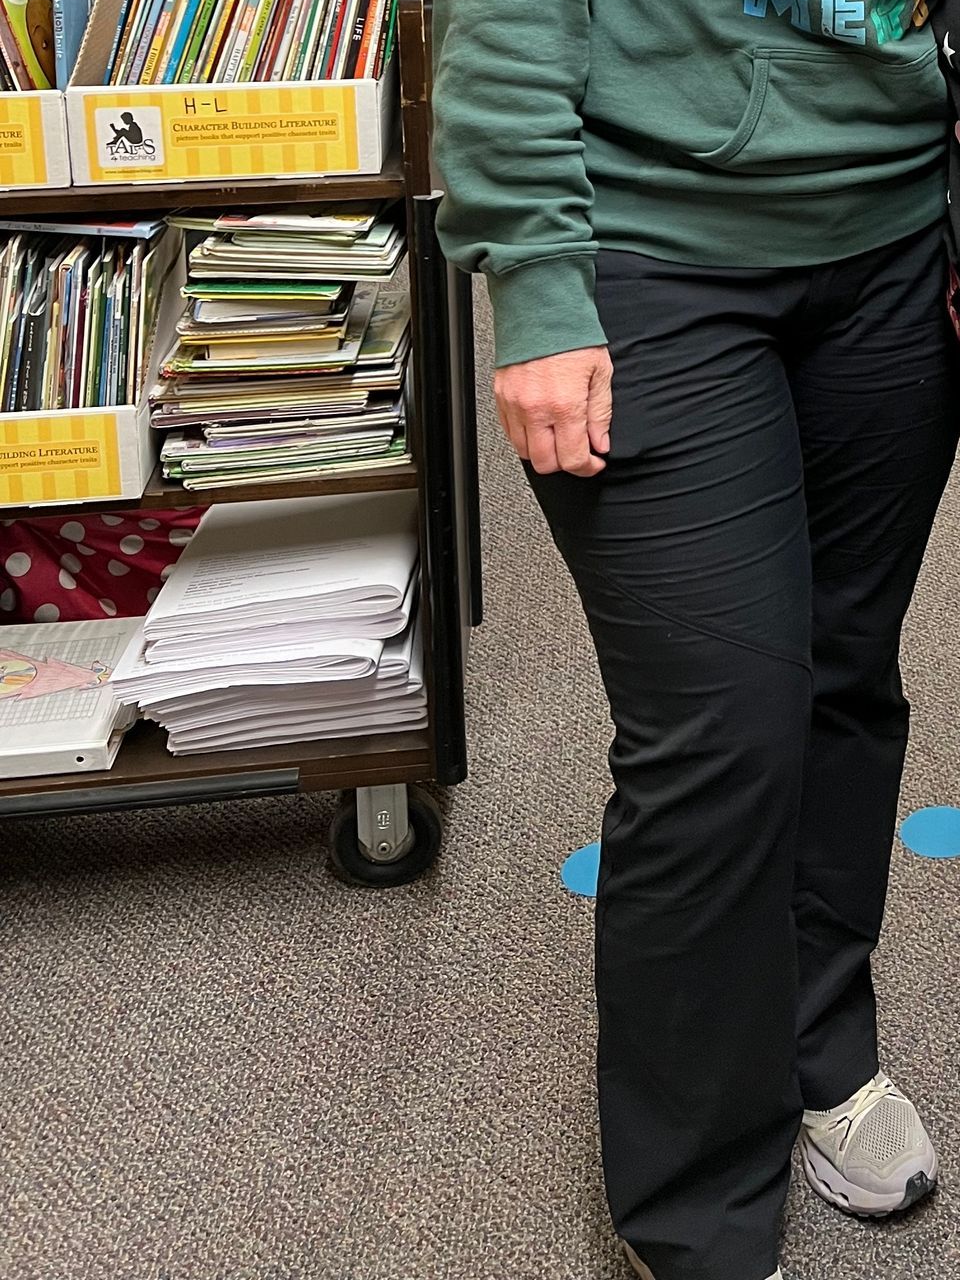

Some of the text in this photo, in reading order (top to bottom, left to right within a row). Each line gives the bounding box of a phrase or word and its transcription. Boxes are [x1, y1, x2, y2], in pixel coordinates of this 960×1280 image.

[353, 16, 365, 42] LIFE
[142, 51, 157, 78] BROKE
[227, 48, 241, 73] HAPPY
[172, 118, 337, 132] CHARACTER BUILDING LITERATURE
[176, 134, 198, 142] picture
[235, 132, 261, 140] support
[261, 131, 287, 139] positive
[38, 446, 98, 456] LITERATURE
